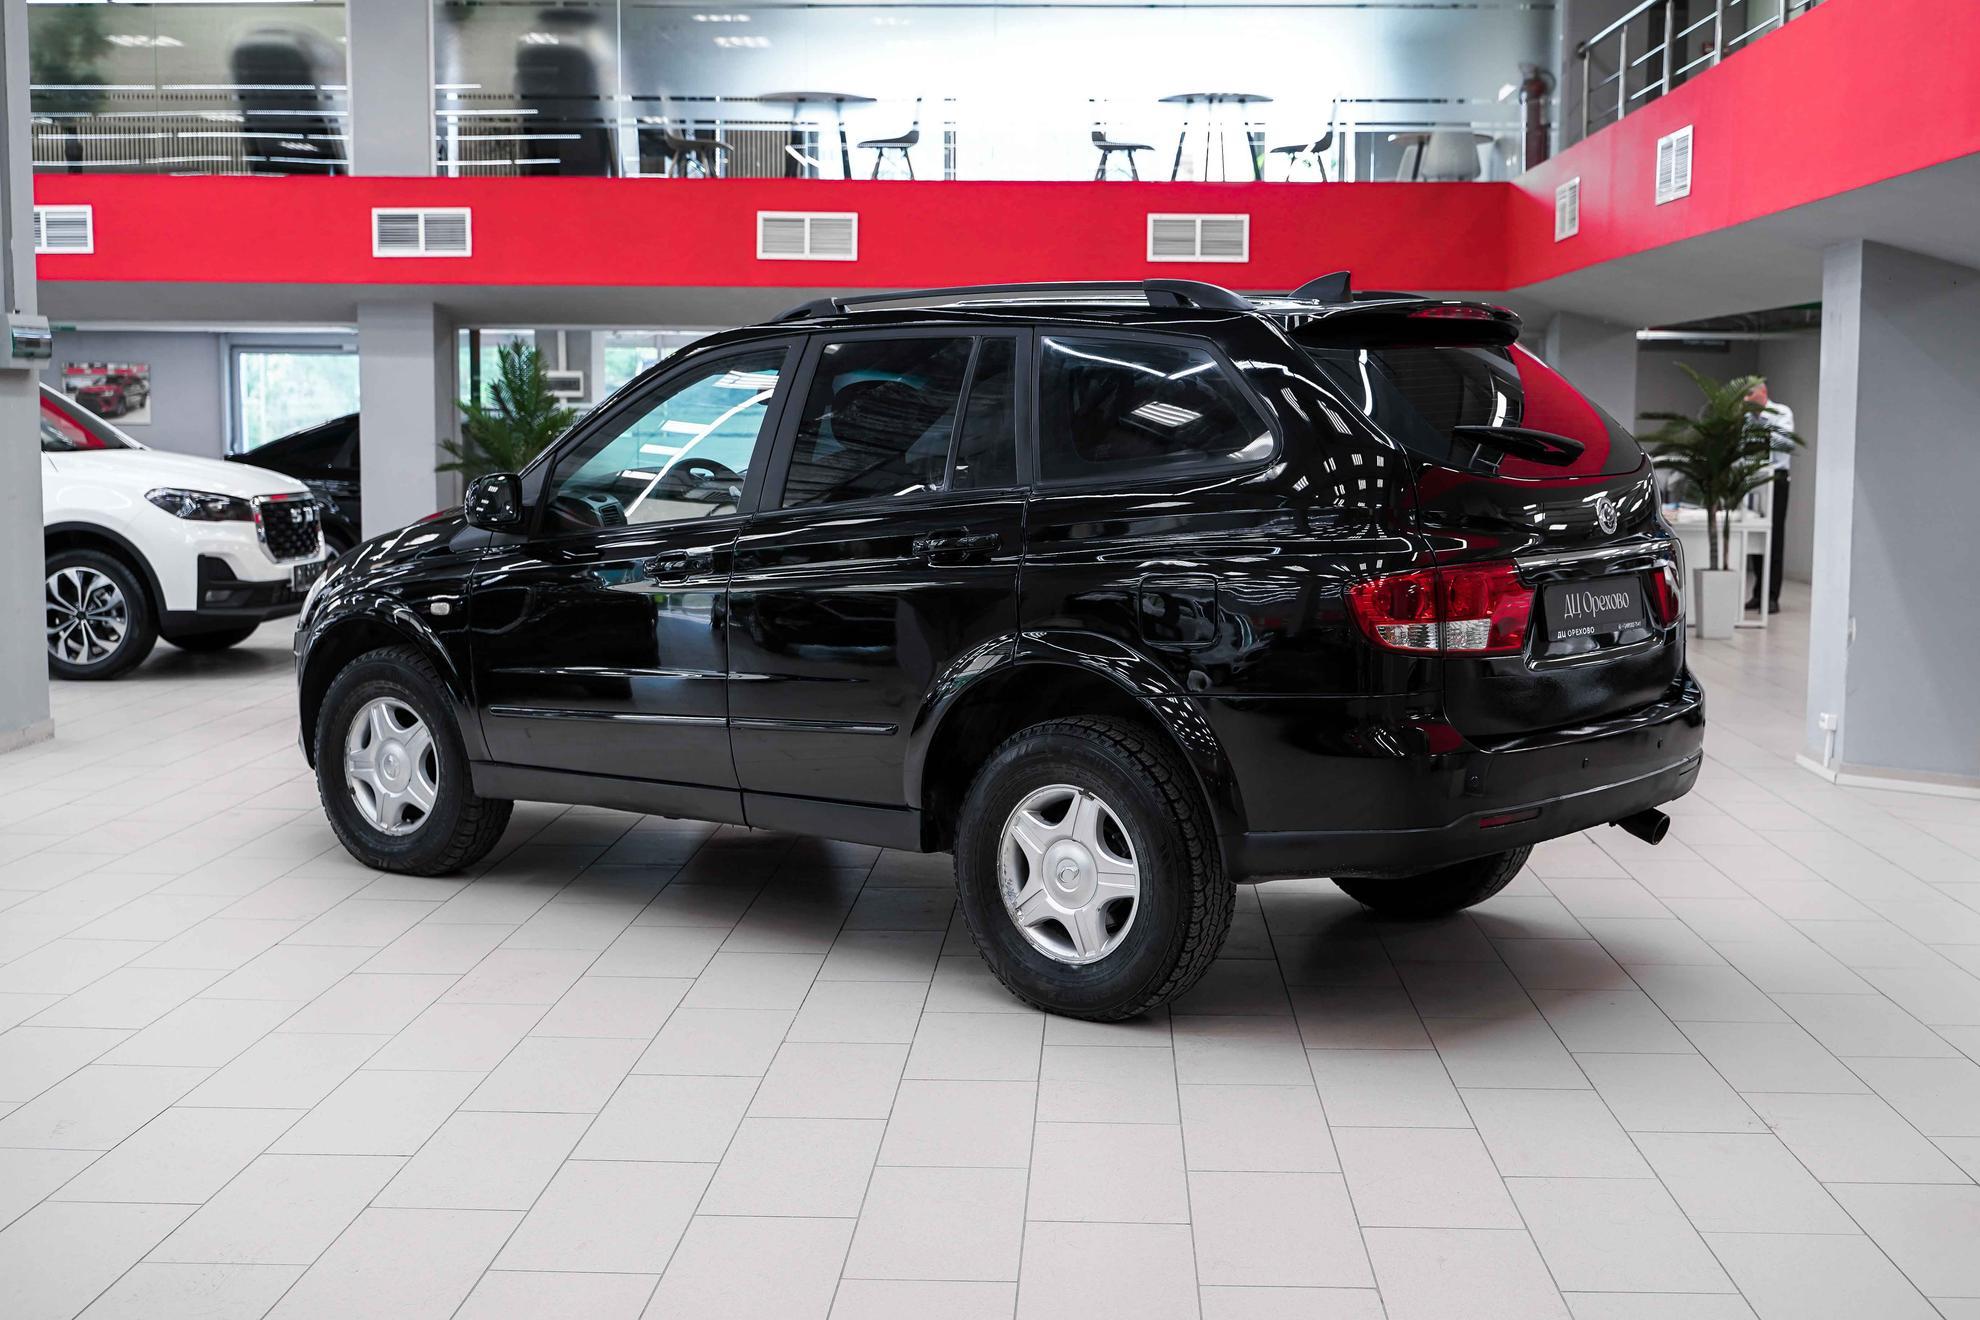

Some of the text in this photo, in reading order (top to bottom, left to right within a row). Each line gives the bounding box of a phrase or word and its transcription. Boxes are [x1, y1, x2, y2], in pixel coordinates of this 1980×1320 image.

[1564, 591, 1630, 619] ДЦ Орехово
[1557, 626, 1595, 639] ДЦ ОРЕХОВО
